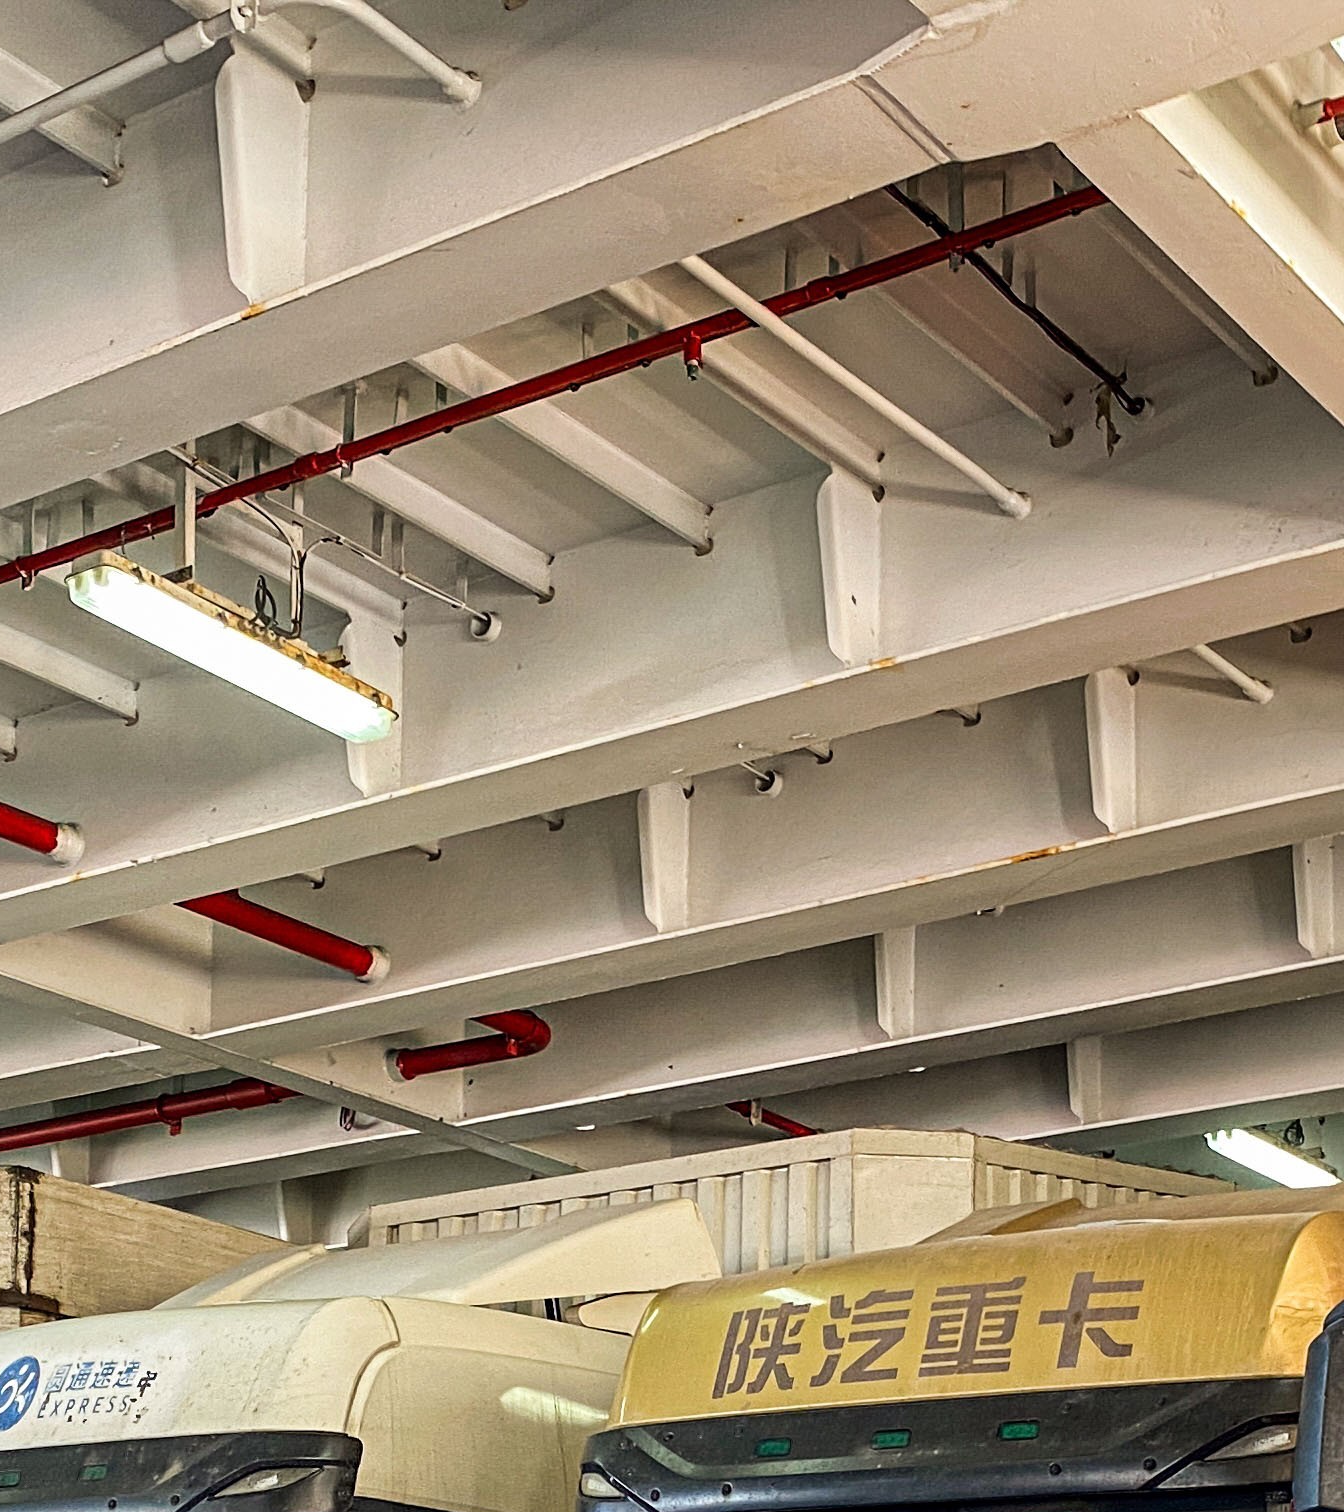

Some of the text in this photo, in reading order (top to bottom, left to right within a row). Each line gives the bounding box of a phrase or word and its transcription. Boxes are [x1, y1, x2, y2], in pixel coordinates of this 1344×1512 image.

[712, 1271, 1144, 1398] 陕汽重卡
[37, 1395, 131, 1418] EXPRESS
